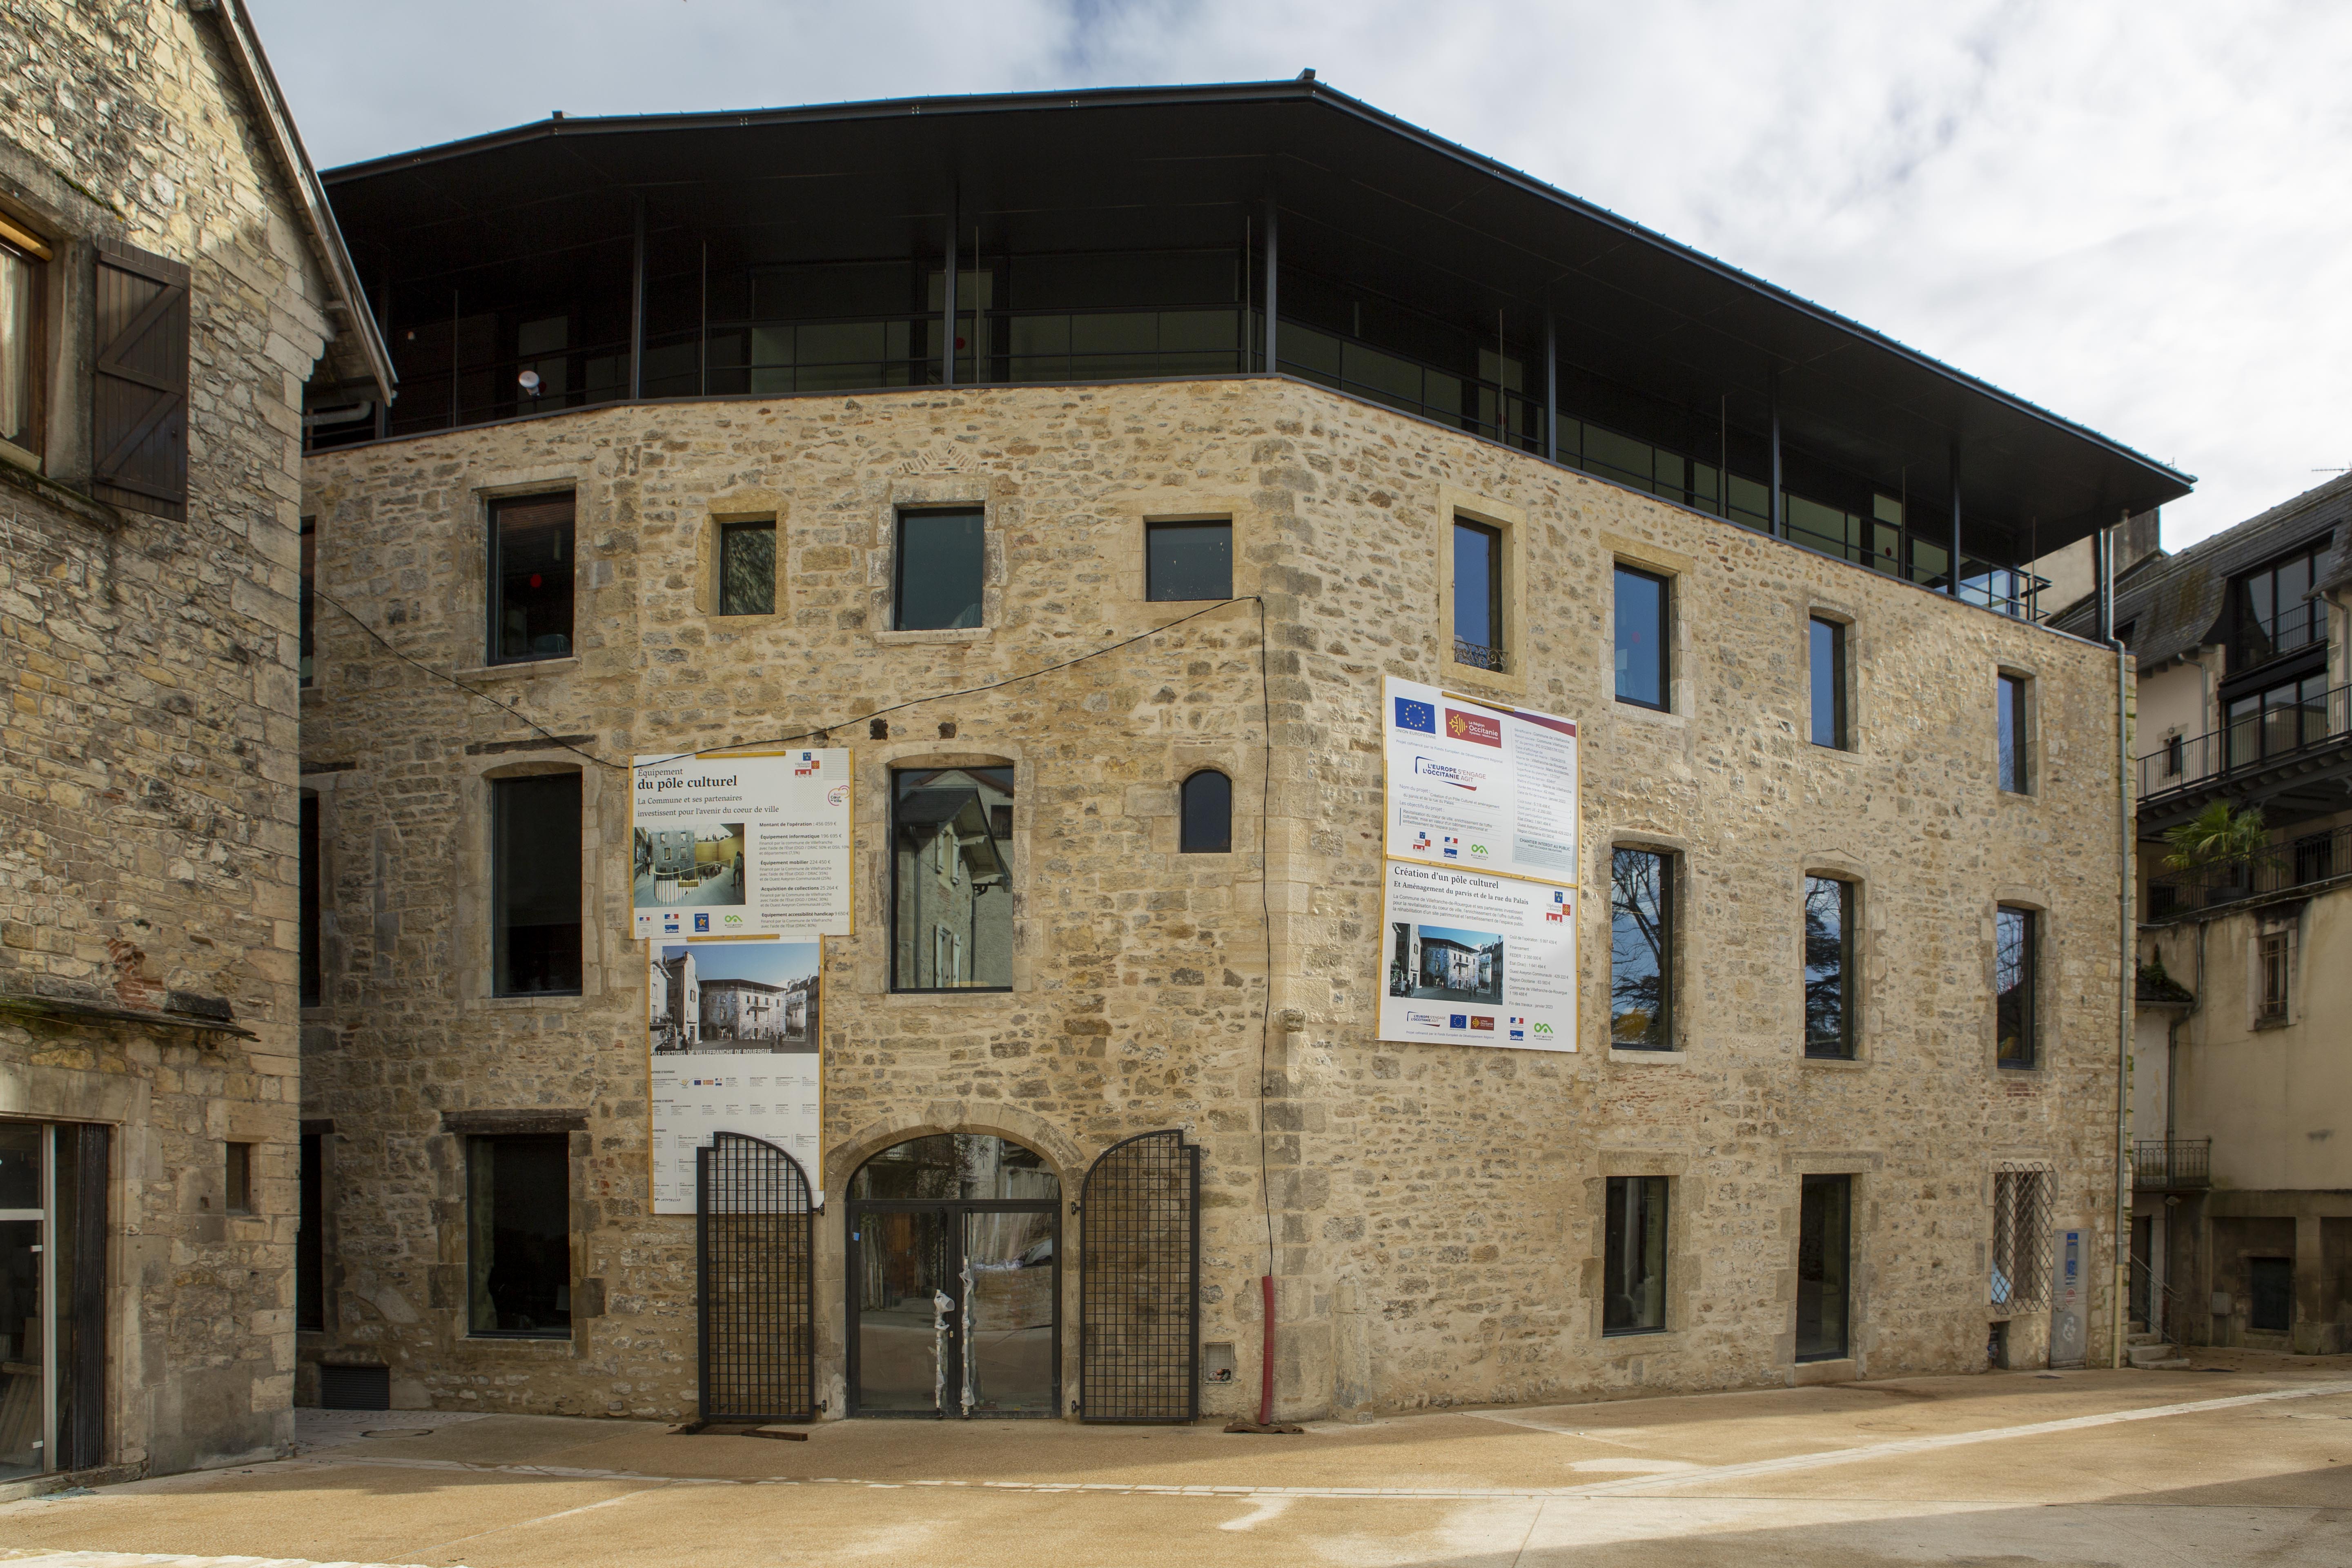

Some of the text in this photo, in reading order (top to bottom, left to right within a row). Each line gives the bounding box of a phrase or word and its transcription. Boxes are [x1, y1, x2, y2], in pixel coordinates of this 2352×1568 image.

[1469, 725, 1498, 736] Occitanie
[638, 768, 683, 778] Équipement
[1423, 768, 1459, 780] L'OCCITANIE
[1428, 764, 1486, 779] L'EUROPE S'ENGAGE
[638, 775, 737, 792] du pôle culturel
[1394, 866, 1498, 889] Création d'un pôle culturel
[1402, 882, 1444, 893] Aménagement
[1426, 898, 1472, 908] Villefranche-de-Rouergue
[1463, 907, 1491, 916] l'enrichissement
